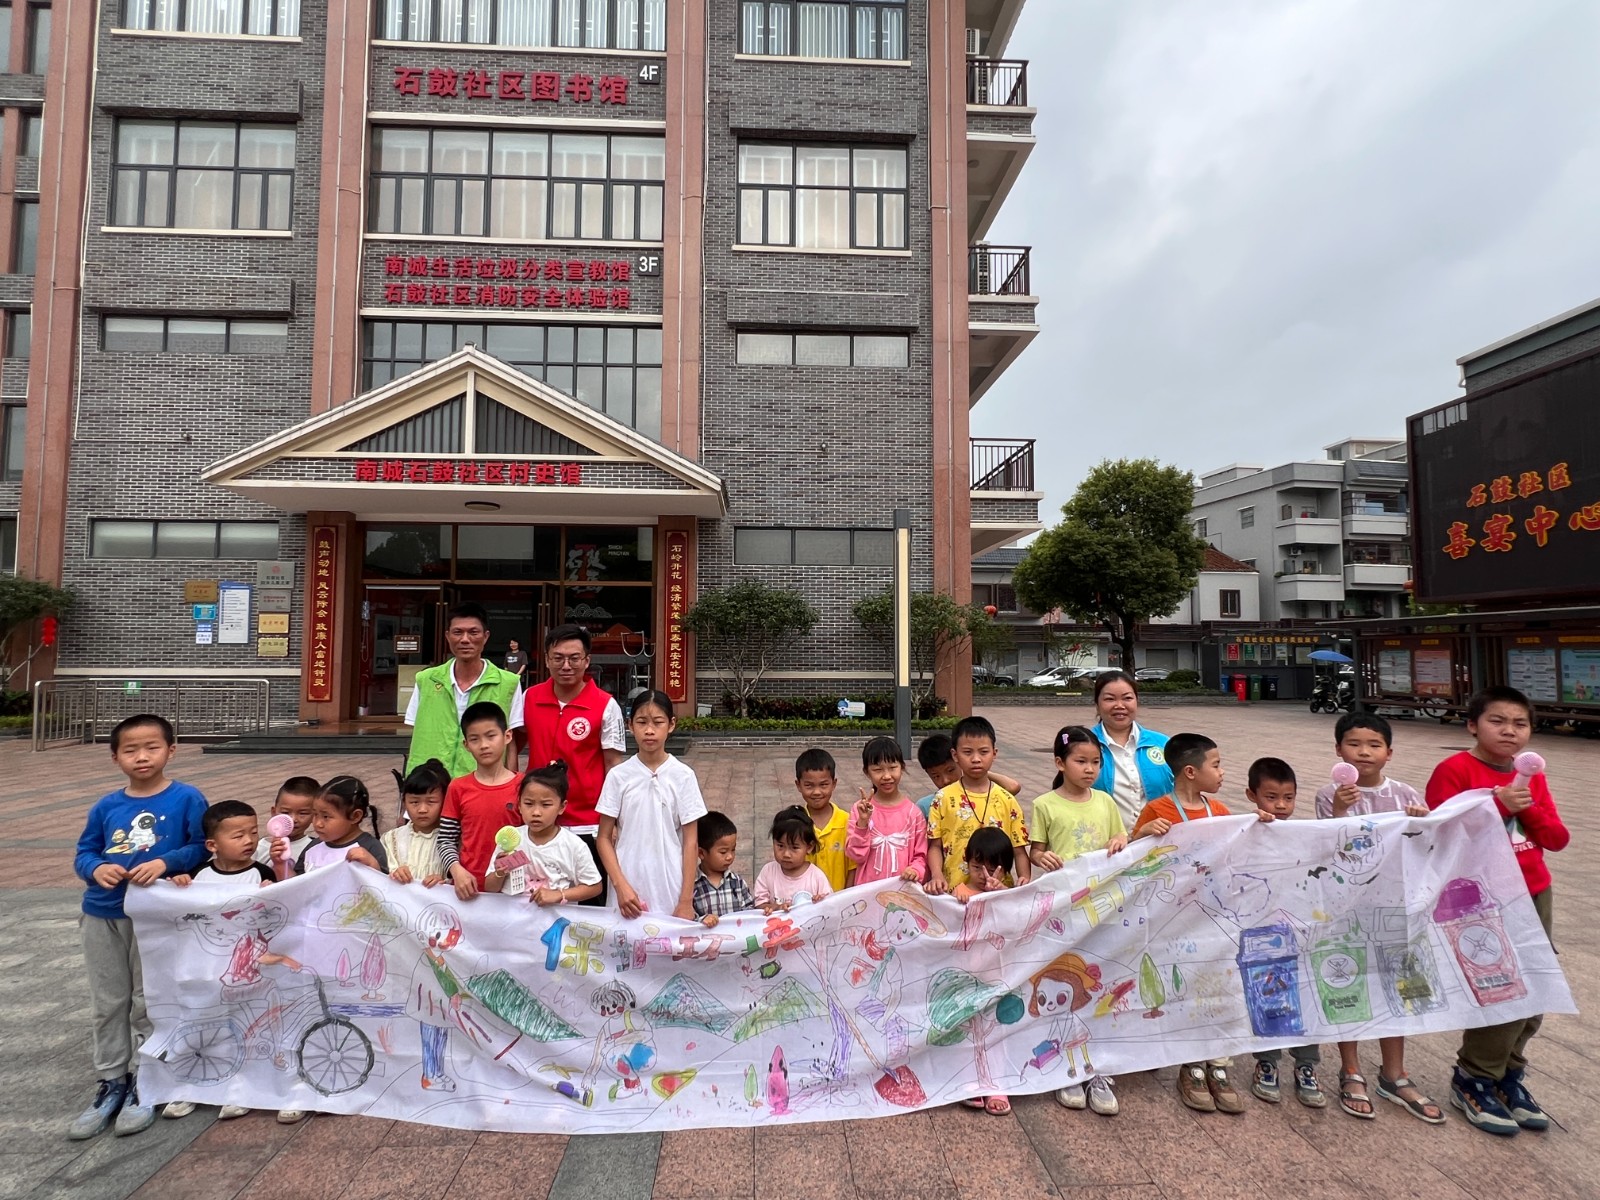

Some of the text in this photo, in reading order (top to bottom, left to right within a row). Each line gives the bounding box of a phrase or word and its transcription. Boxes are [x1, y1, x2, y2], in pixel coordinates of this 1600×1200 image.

[394, 66, 629, 105] 石鼓社区图书馆
[639, 64, 659, 81] 4F
[384, 255, 631, 281] 南城生活垃圾分类宣教馆
[639, 256, 659, 272] 3F
[384, 283, 631, 309] 石鼓社区消防安全体验馆
[355, 459, 582, 485] 南城石鼓社区村史馆
[1466, 462, 1572, 508] 石鼓社区
[1442, 501, 1600, 560] 喜宴中心
